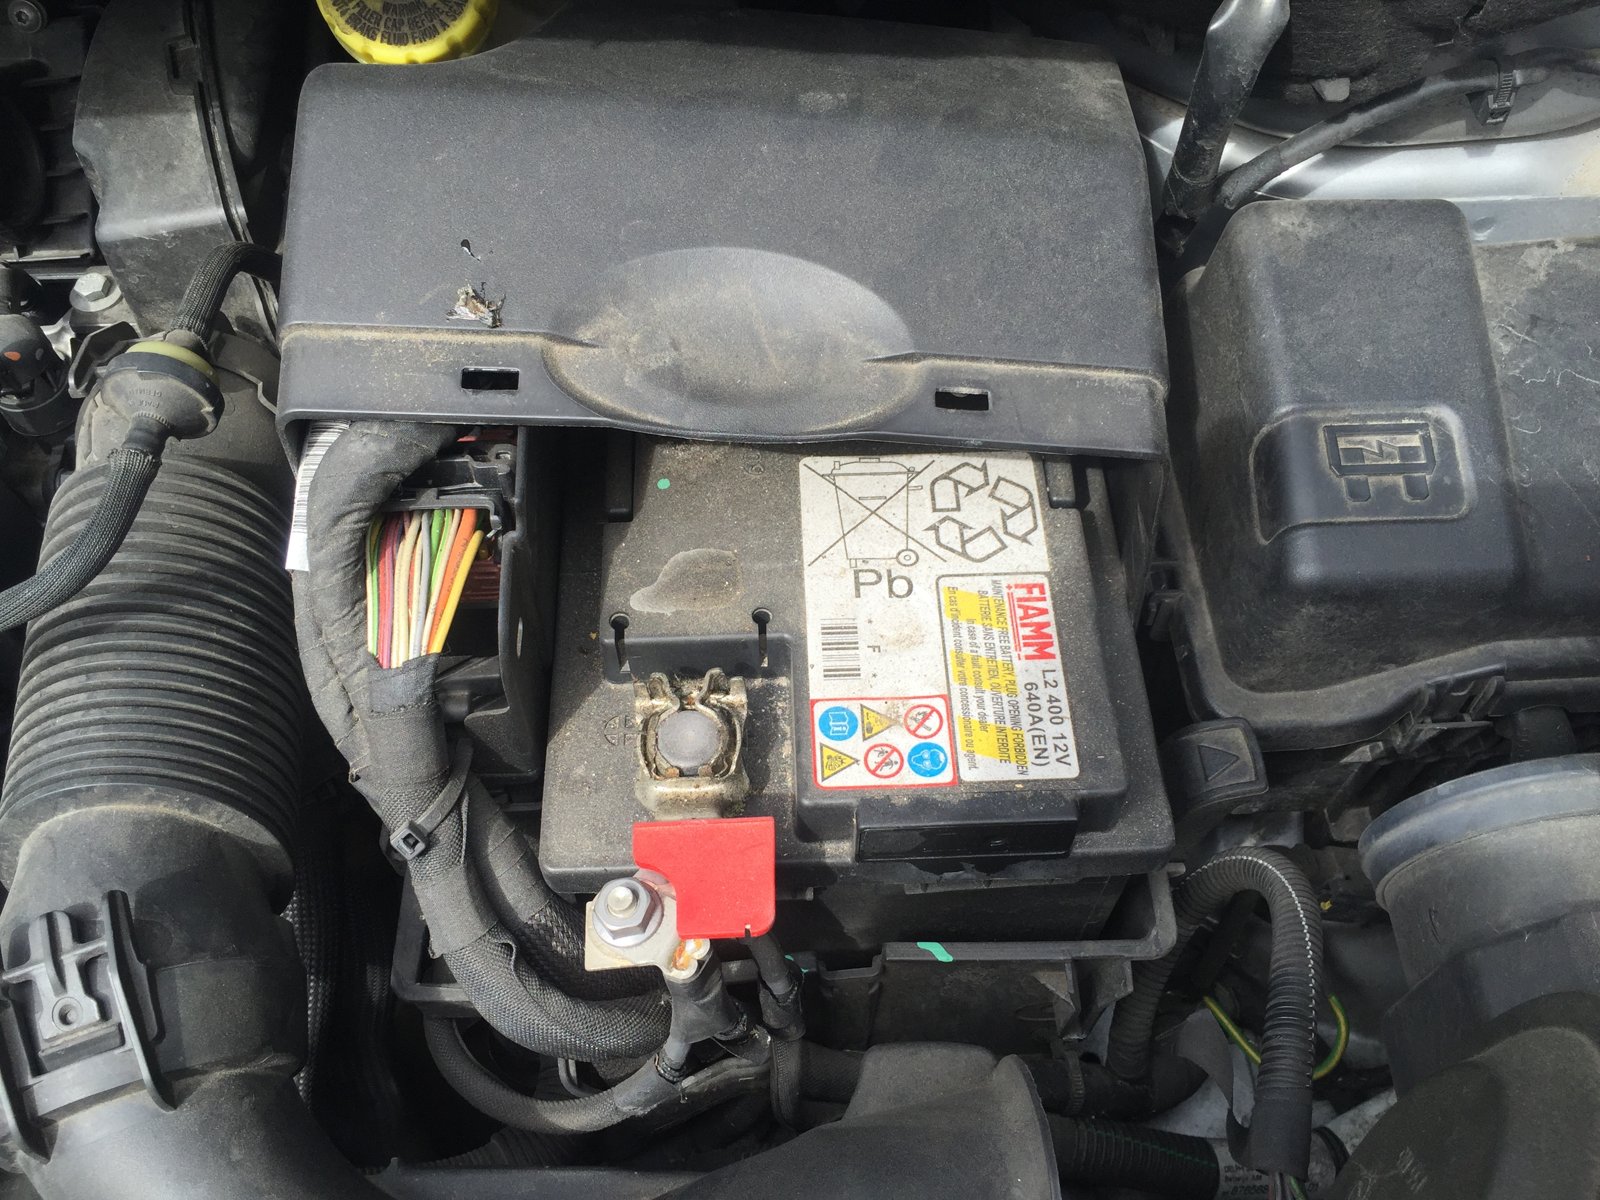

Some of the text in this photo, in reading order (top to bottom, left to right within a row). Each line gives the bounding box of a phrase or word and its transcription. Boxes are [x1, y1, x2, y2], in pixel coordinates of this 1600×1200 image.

[345, 13, 380, 41] BRAKE
[380, 31, 408, 46] FLUID
[411, 24, 440, 45] FROM
[384, 17, 404, 31] CAP
[853, 569, 914, 598] Pb
[949, 596, 957, 606] cas
[977, 590, 992, 621] BATTERIE
[967, 626, 975, 640] case
[982, 623, 995, 640] SANS
[1014, 582, 1056, 660] FIAMM
[867, 645, 881, 653] F
[954, 639, 966, 669] consulter
[971, 654, 982, 669] fault
[956, 670, 967, 686] votre
[973, 671, 986, 695] consult
[991, 580, 1028, 775] MAINTENANCE FREE BATTERY, PLUG OPENING FORBIDDEN
[960, 688, 975, 738] concessionaire
[973, 695, 985, 710] your
[990, 682, 1005, 724] OUVERTURE
[978, 712, 990, 733] dealer
[1024, 682, 1050, 767] 640A(EN)
[1042, 670, 1071, 766] L2 400 12V
[966, 739, 975, 748] ou
[995, 726, 1011, 764] INTERDITE
